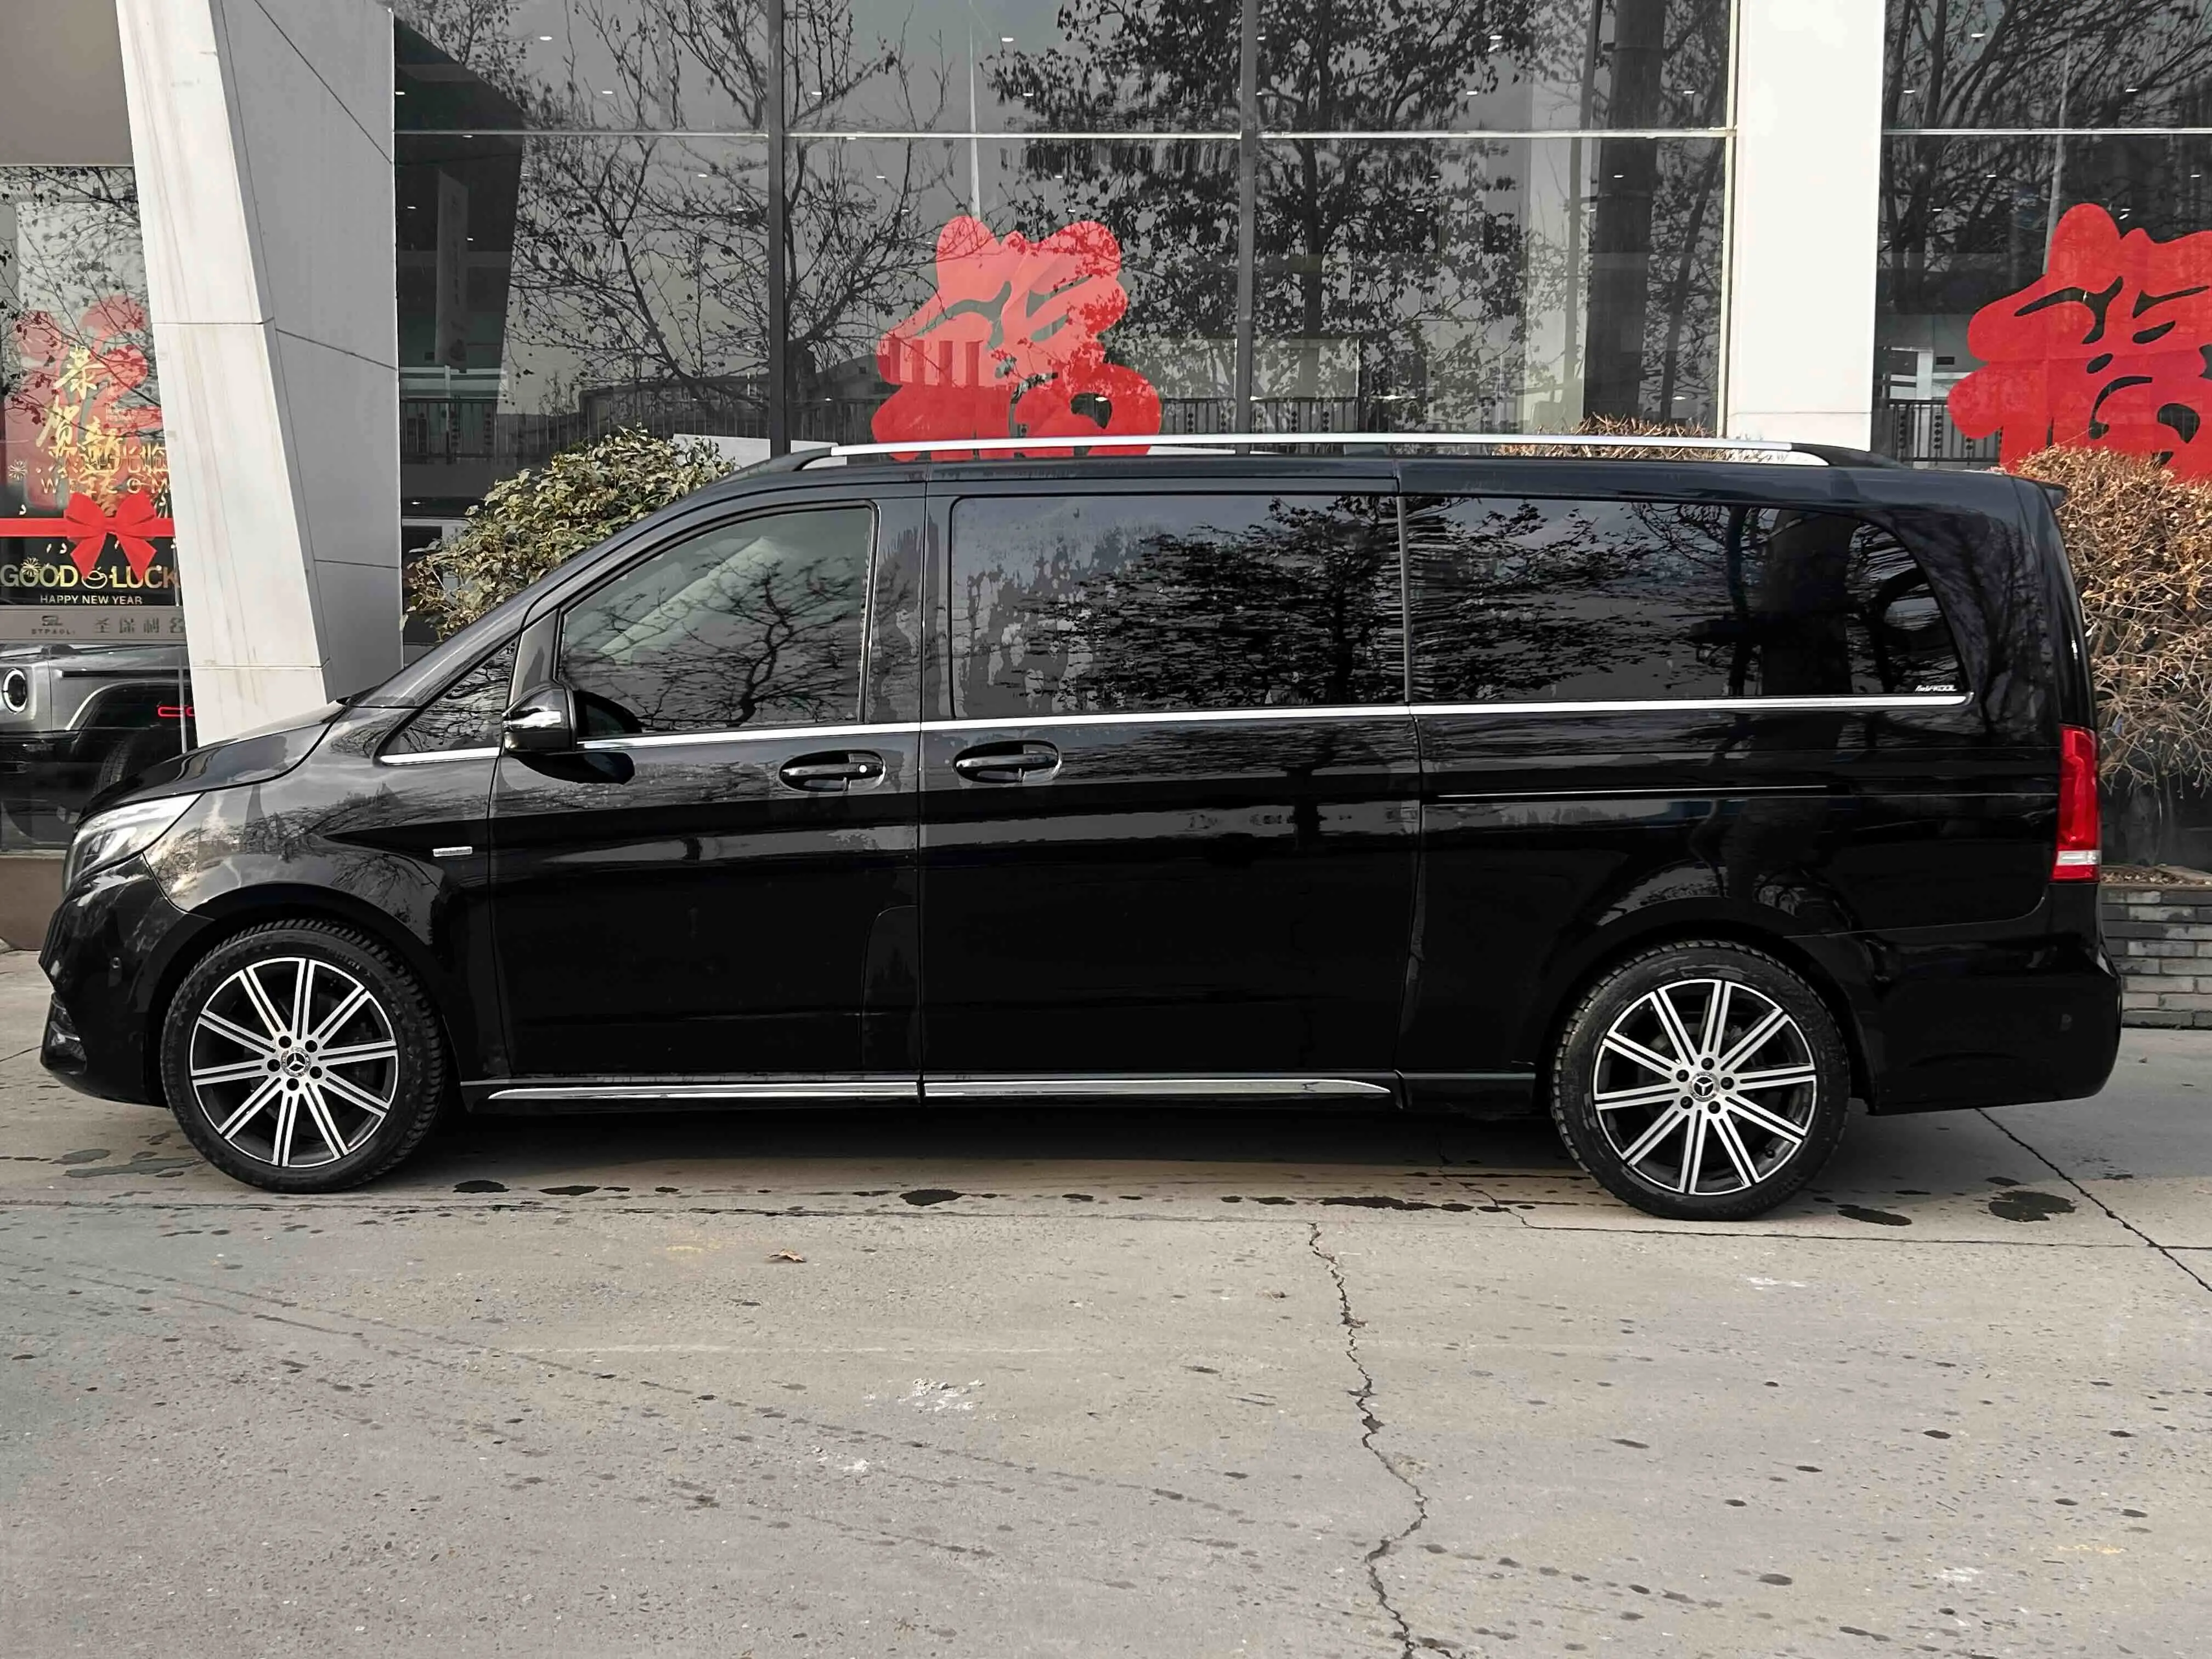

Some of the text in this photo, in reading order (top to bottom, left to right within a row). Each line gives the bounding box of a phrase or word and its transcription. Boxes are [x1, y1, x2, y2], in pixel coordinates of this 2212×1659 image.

[0, 564, 180, 589] GOOD LUCK
[40, 595, 143, 605] HAPPY NEW YEAR
